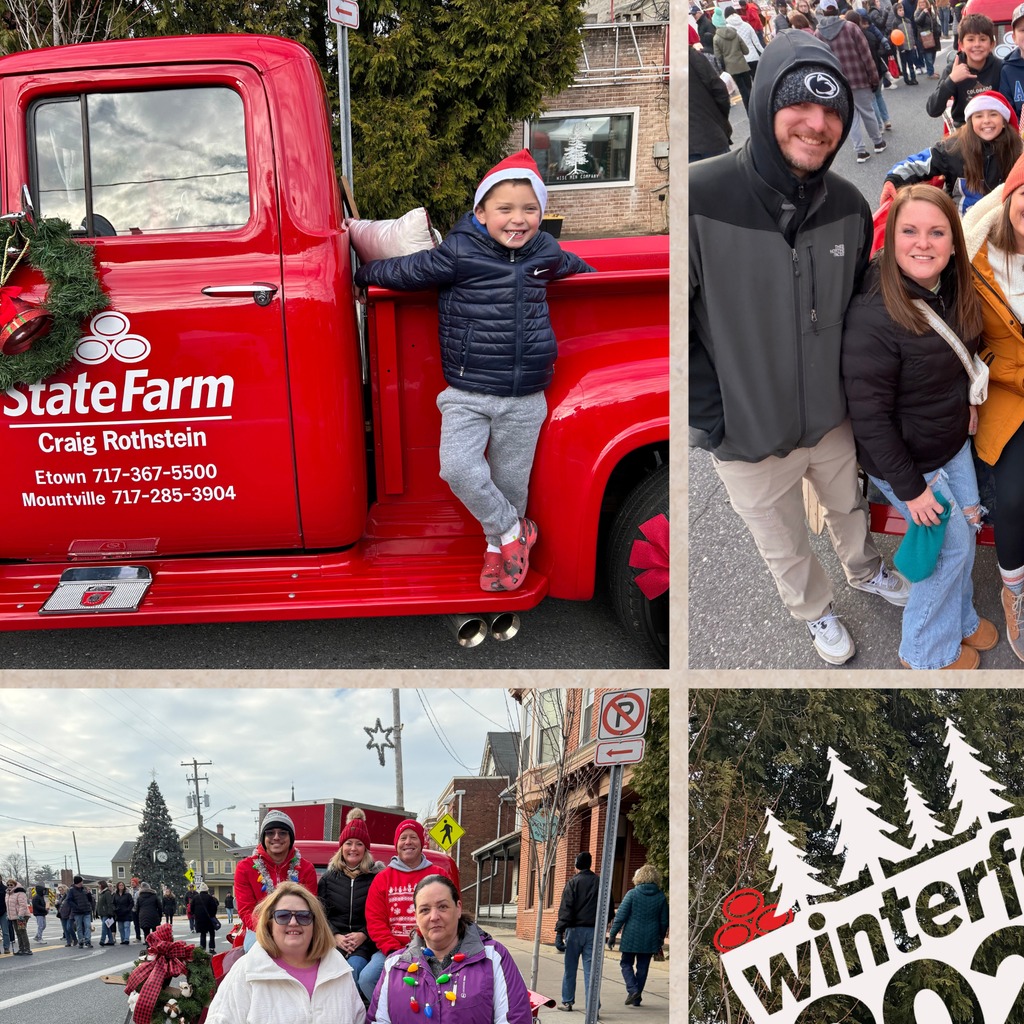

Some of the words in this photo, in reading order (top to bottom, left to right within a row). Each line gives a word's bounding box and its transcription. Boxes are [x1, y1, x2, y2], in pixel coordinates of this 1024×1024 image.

[38, 431, 98, 456] Craig
[103, 427, 207, 451] Rothstein
[35, 469, 87, 485] Etown
[92, 463, 218, 484] 717-367-5500
[21, 490, 106, 507] Mountville
[112, 485, 237, 506] 717-285-3904
